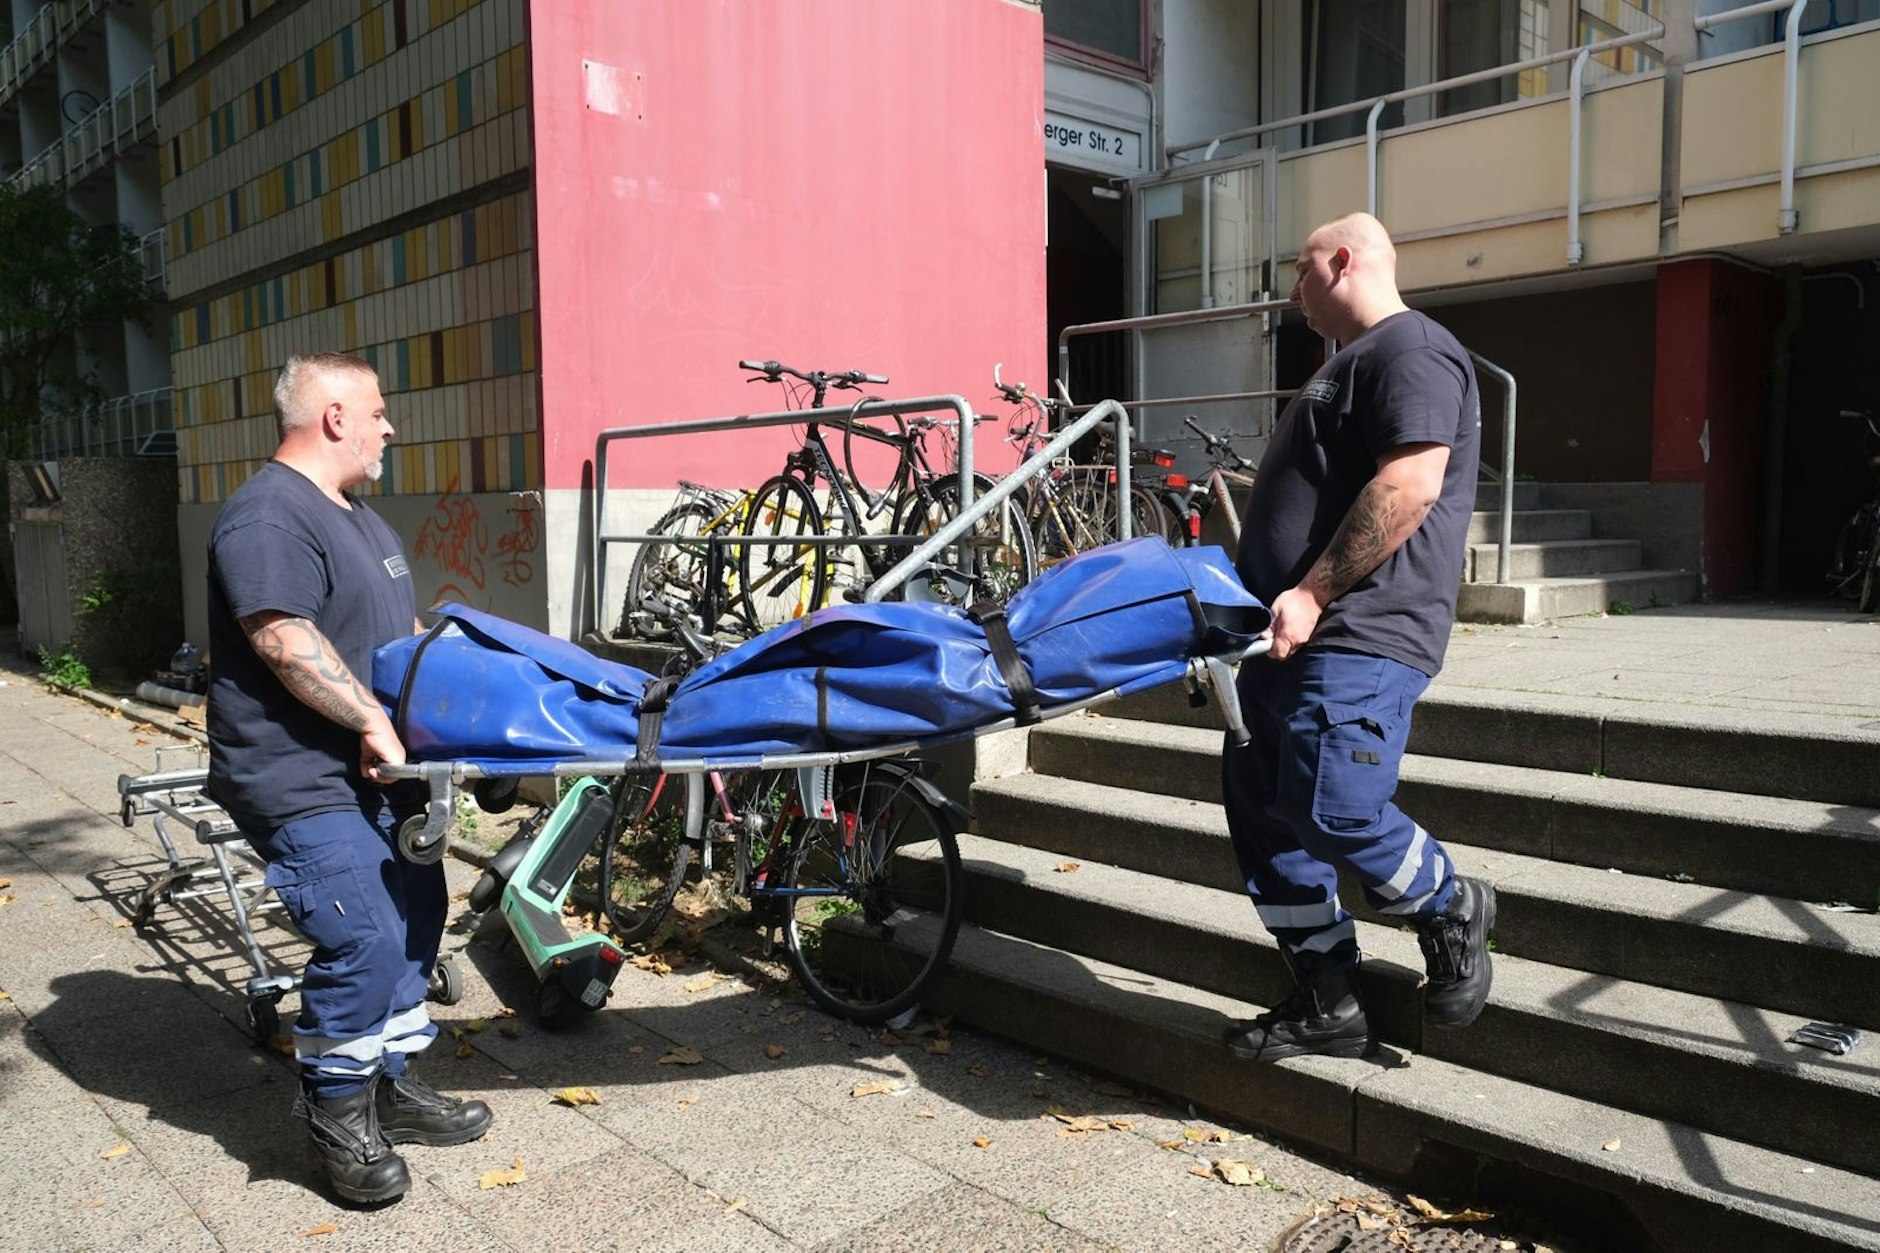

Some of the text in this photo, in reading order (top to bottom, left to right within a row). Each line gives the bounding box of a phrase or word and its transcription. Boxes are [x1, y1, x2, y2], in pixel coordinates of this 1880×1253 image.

[1044, 124, 1123, 155] erger Str. 2
